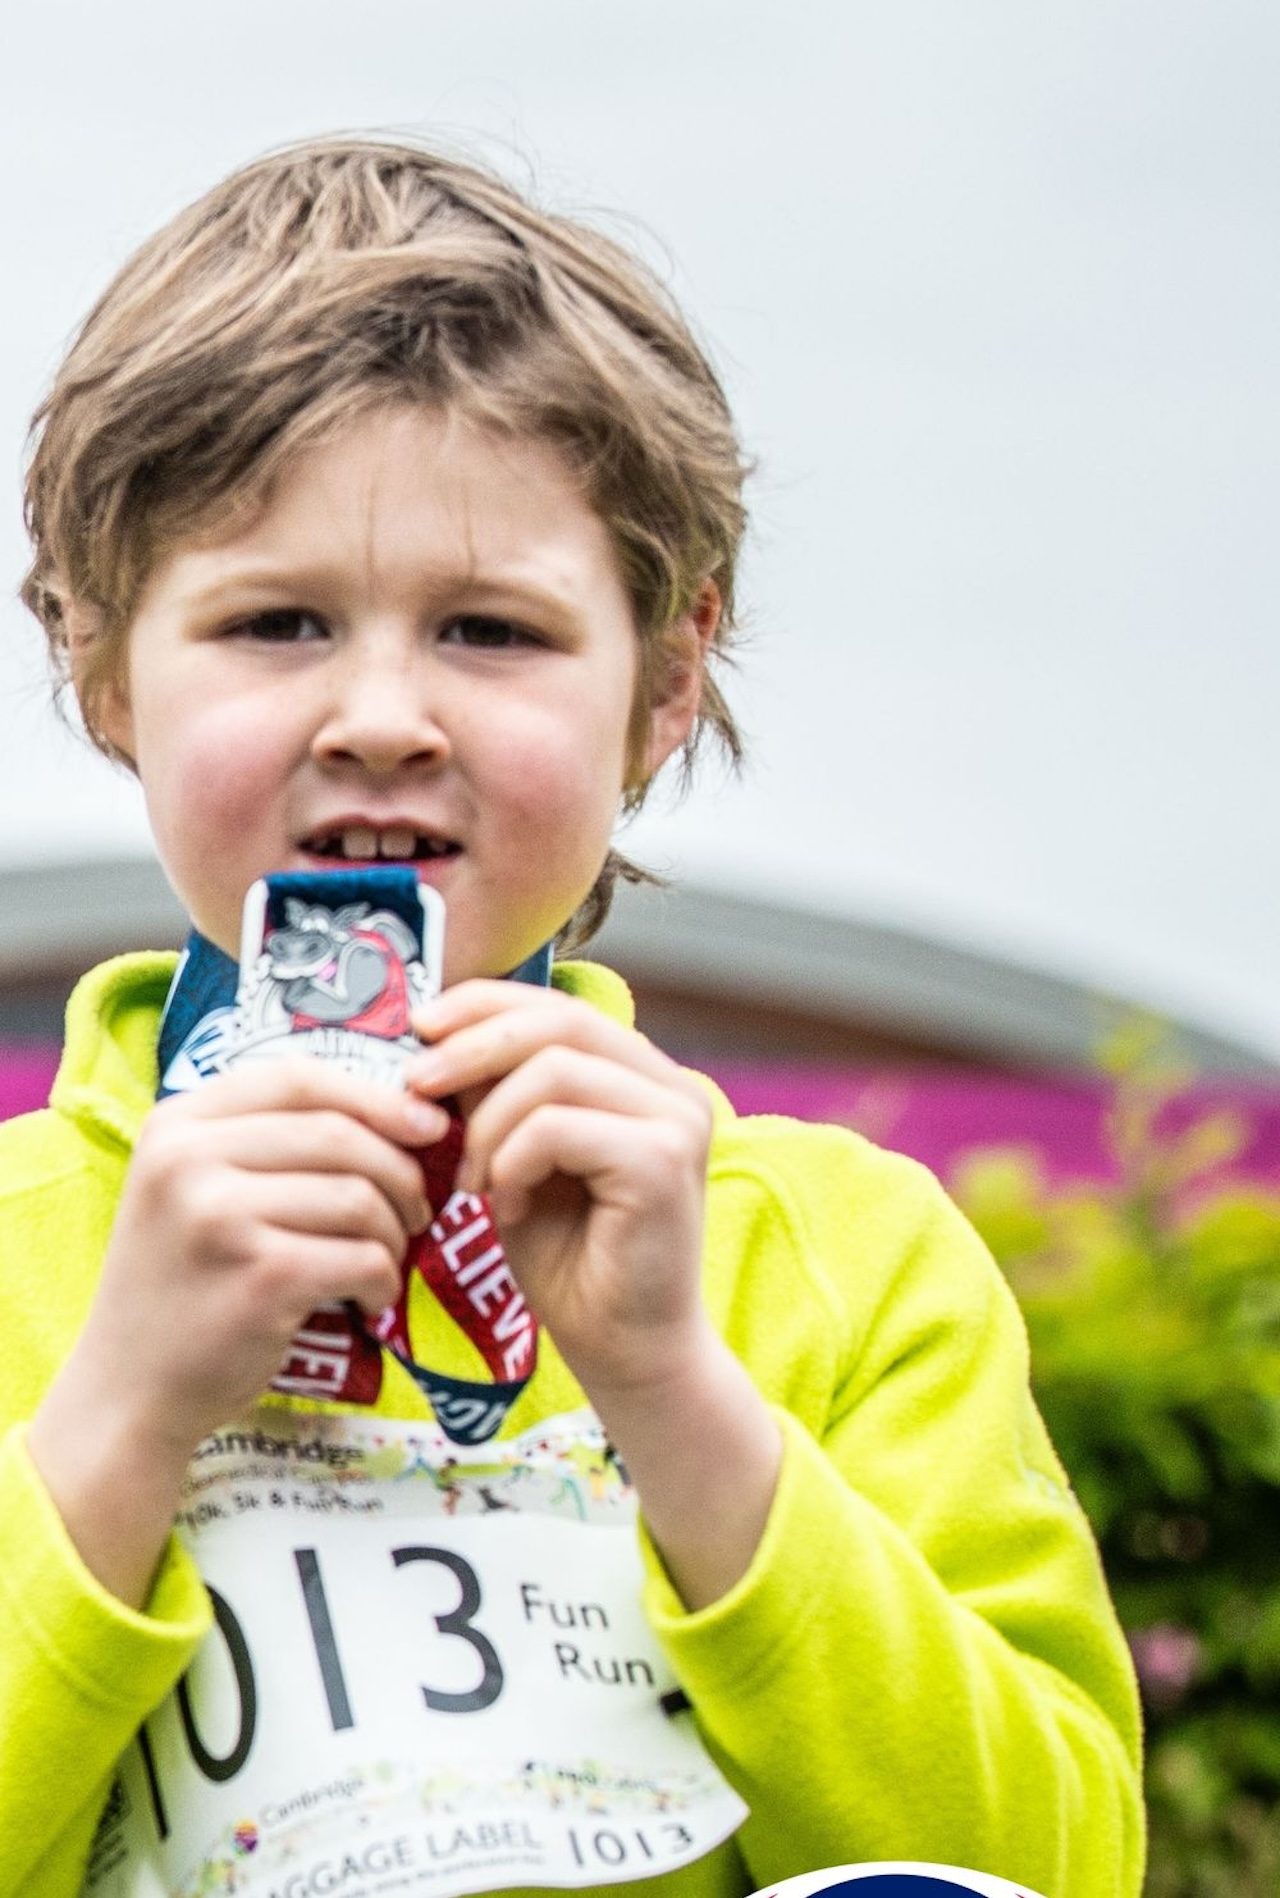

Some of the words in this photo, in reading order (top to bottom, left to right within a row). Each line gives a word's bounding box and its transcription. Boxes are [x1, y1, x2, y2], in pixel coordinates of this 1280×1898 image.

[429, 1188, 535, 1383] ELIEVE
[520, 1582, 610, 1630] Fun
[554, 1642, 656, 1688] Run
[266, 1834, 416, 1898] GGAGE
[427, 1819, 543, 1860] LABEL
[568, 1823, 695, 1868] 1013
